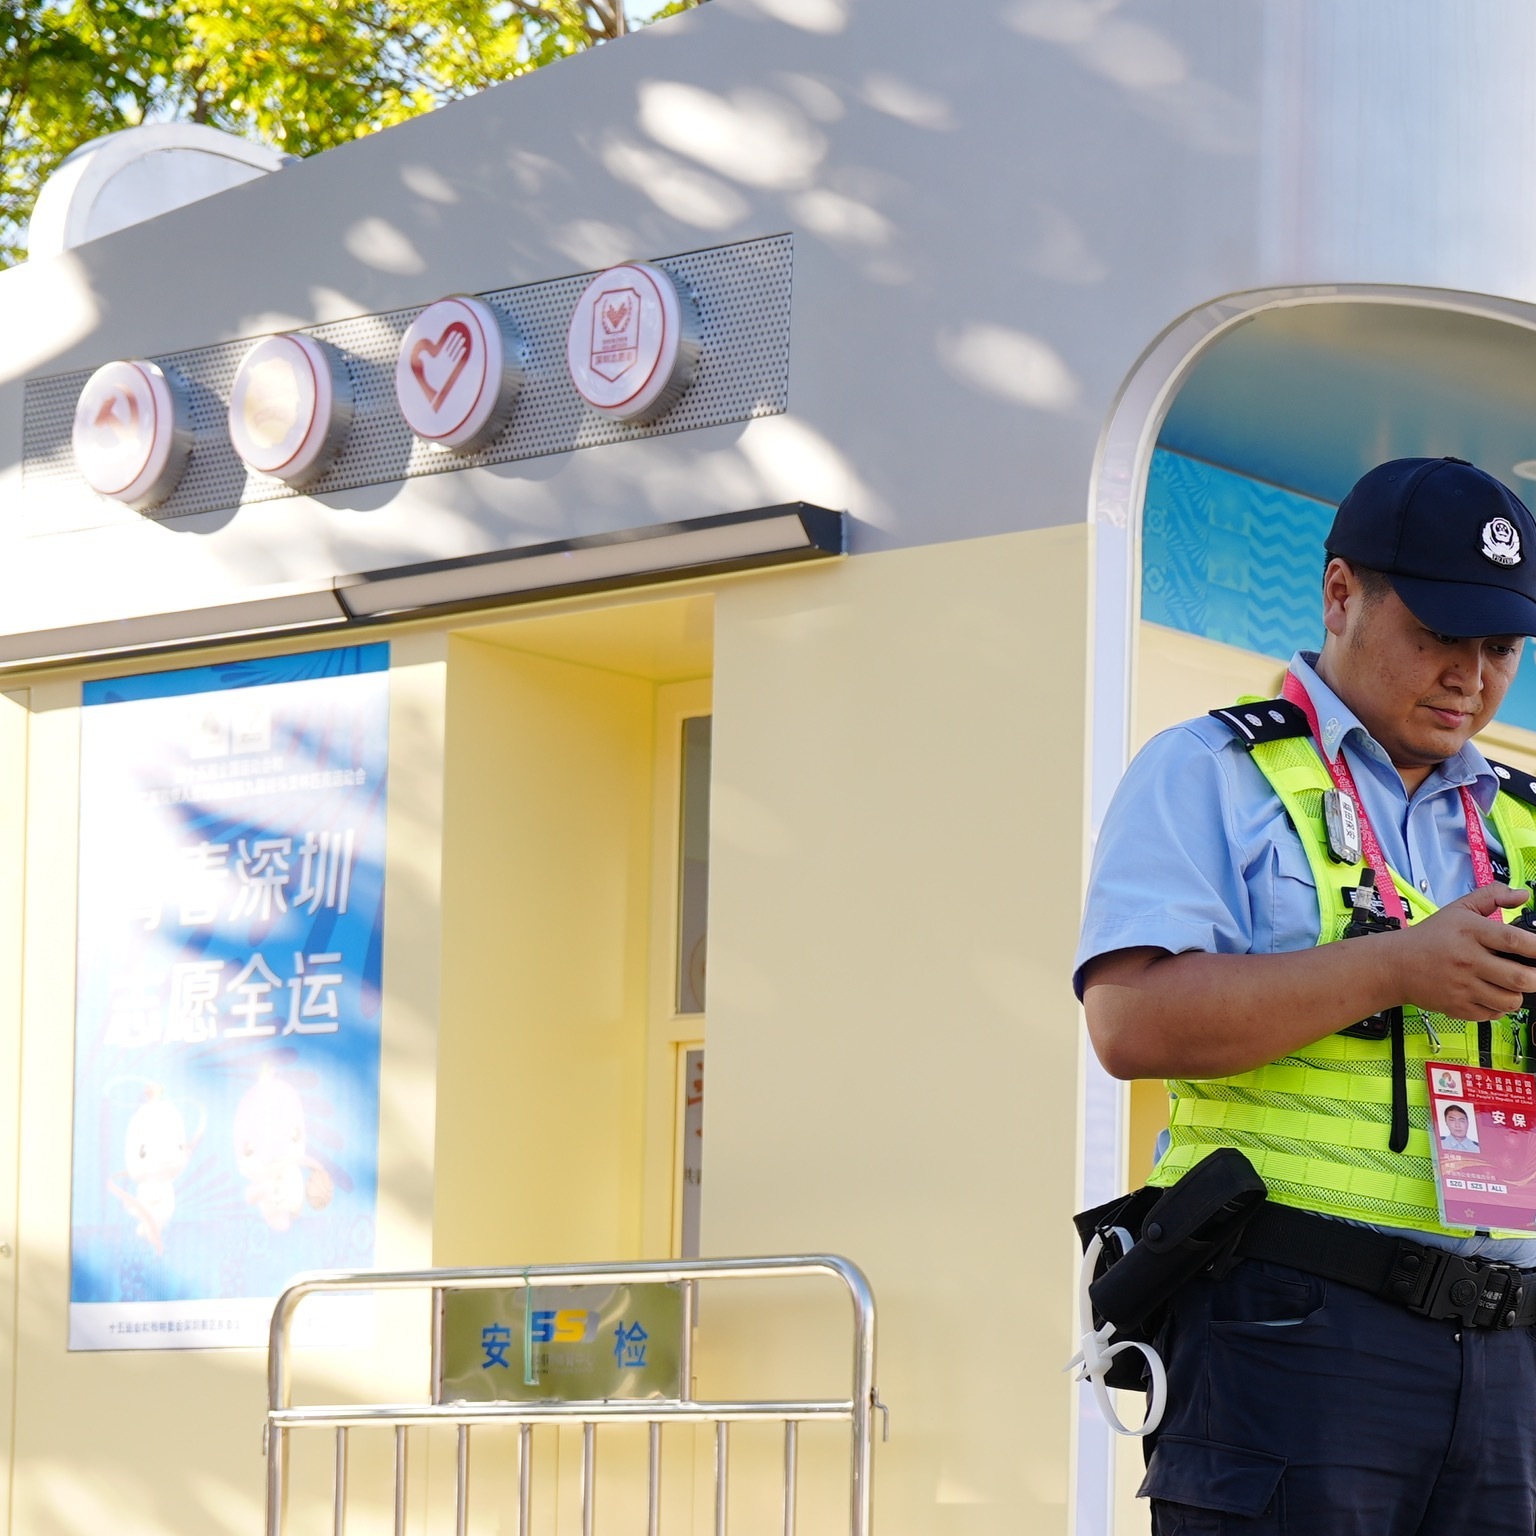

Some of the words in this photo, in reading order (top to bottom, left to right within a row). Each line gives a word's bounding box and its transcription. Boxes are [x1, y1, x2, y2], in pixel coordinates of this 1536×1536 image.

[103, 950, 345, 1048] 志愿全运
[1464, 1072, 1532, 1088] 中华人民共和国
[1491, 1110, 1528, 1128] 安保
[480, 1322, 512, 1370] 安
[613, 1320, 649, 1369] 检
